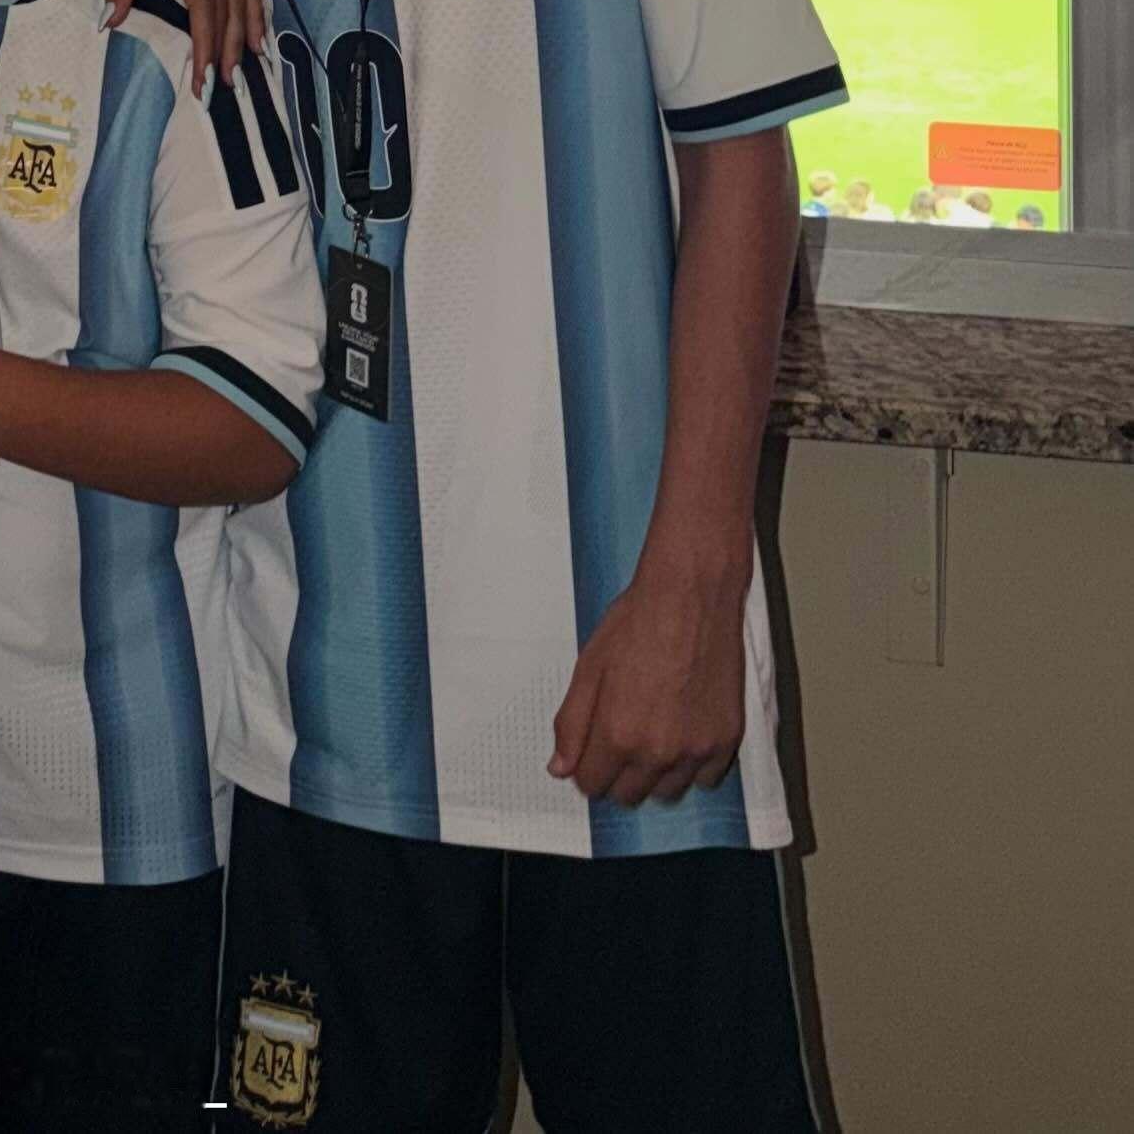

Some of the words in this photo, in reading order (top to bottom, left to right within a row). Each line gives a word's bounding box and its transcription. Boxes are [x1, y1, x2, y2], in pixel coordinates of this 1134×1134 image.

[276, 29, 413, 224] 10
[8, 140, 57, 194] AFA
[250, 1032, 297, 1090] AFA
